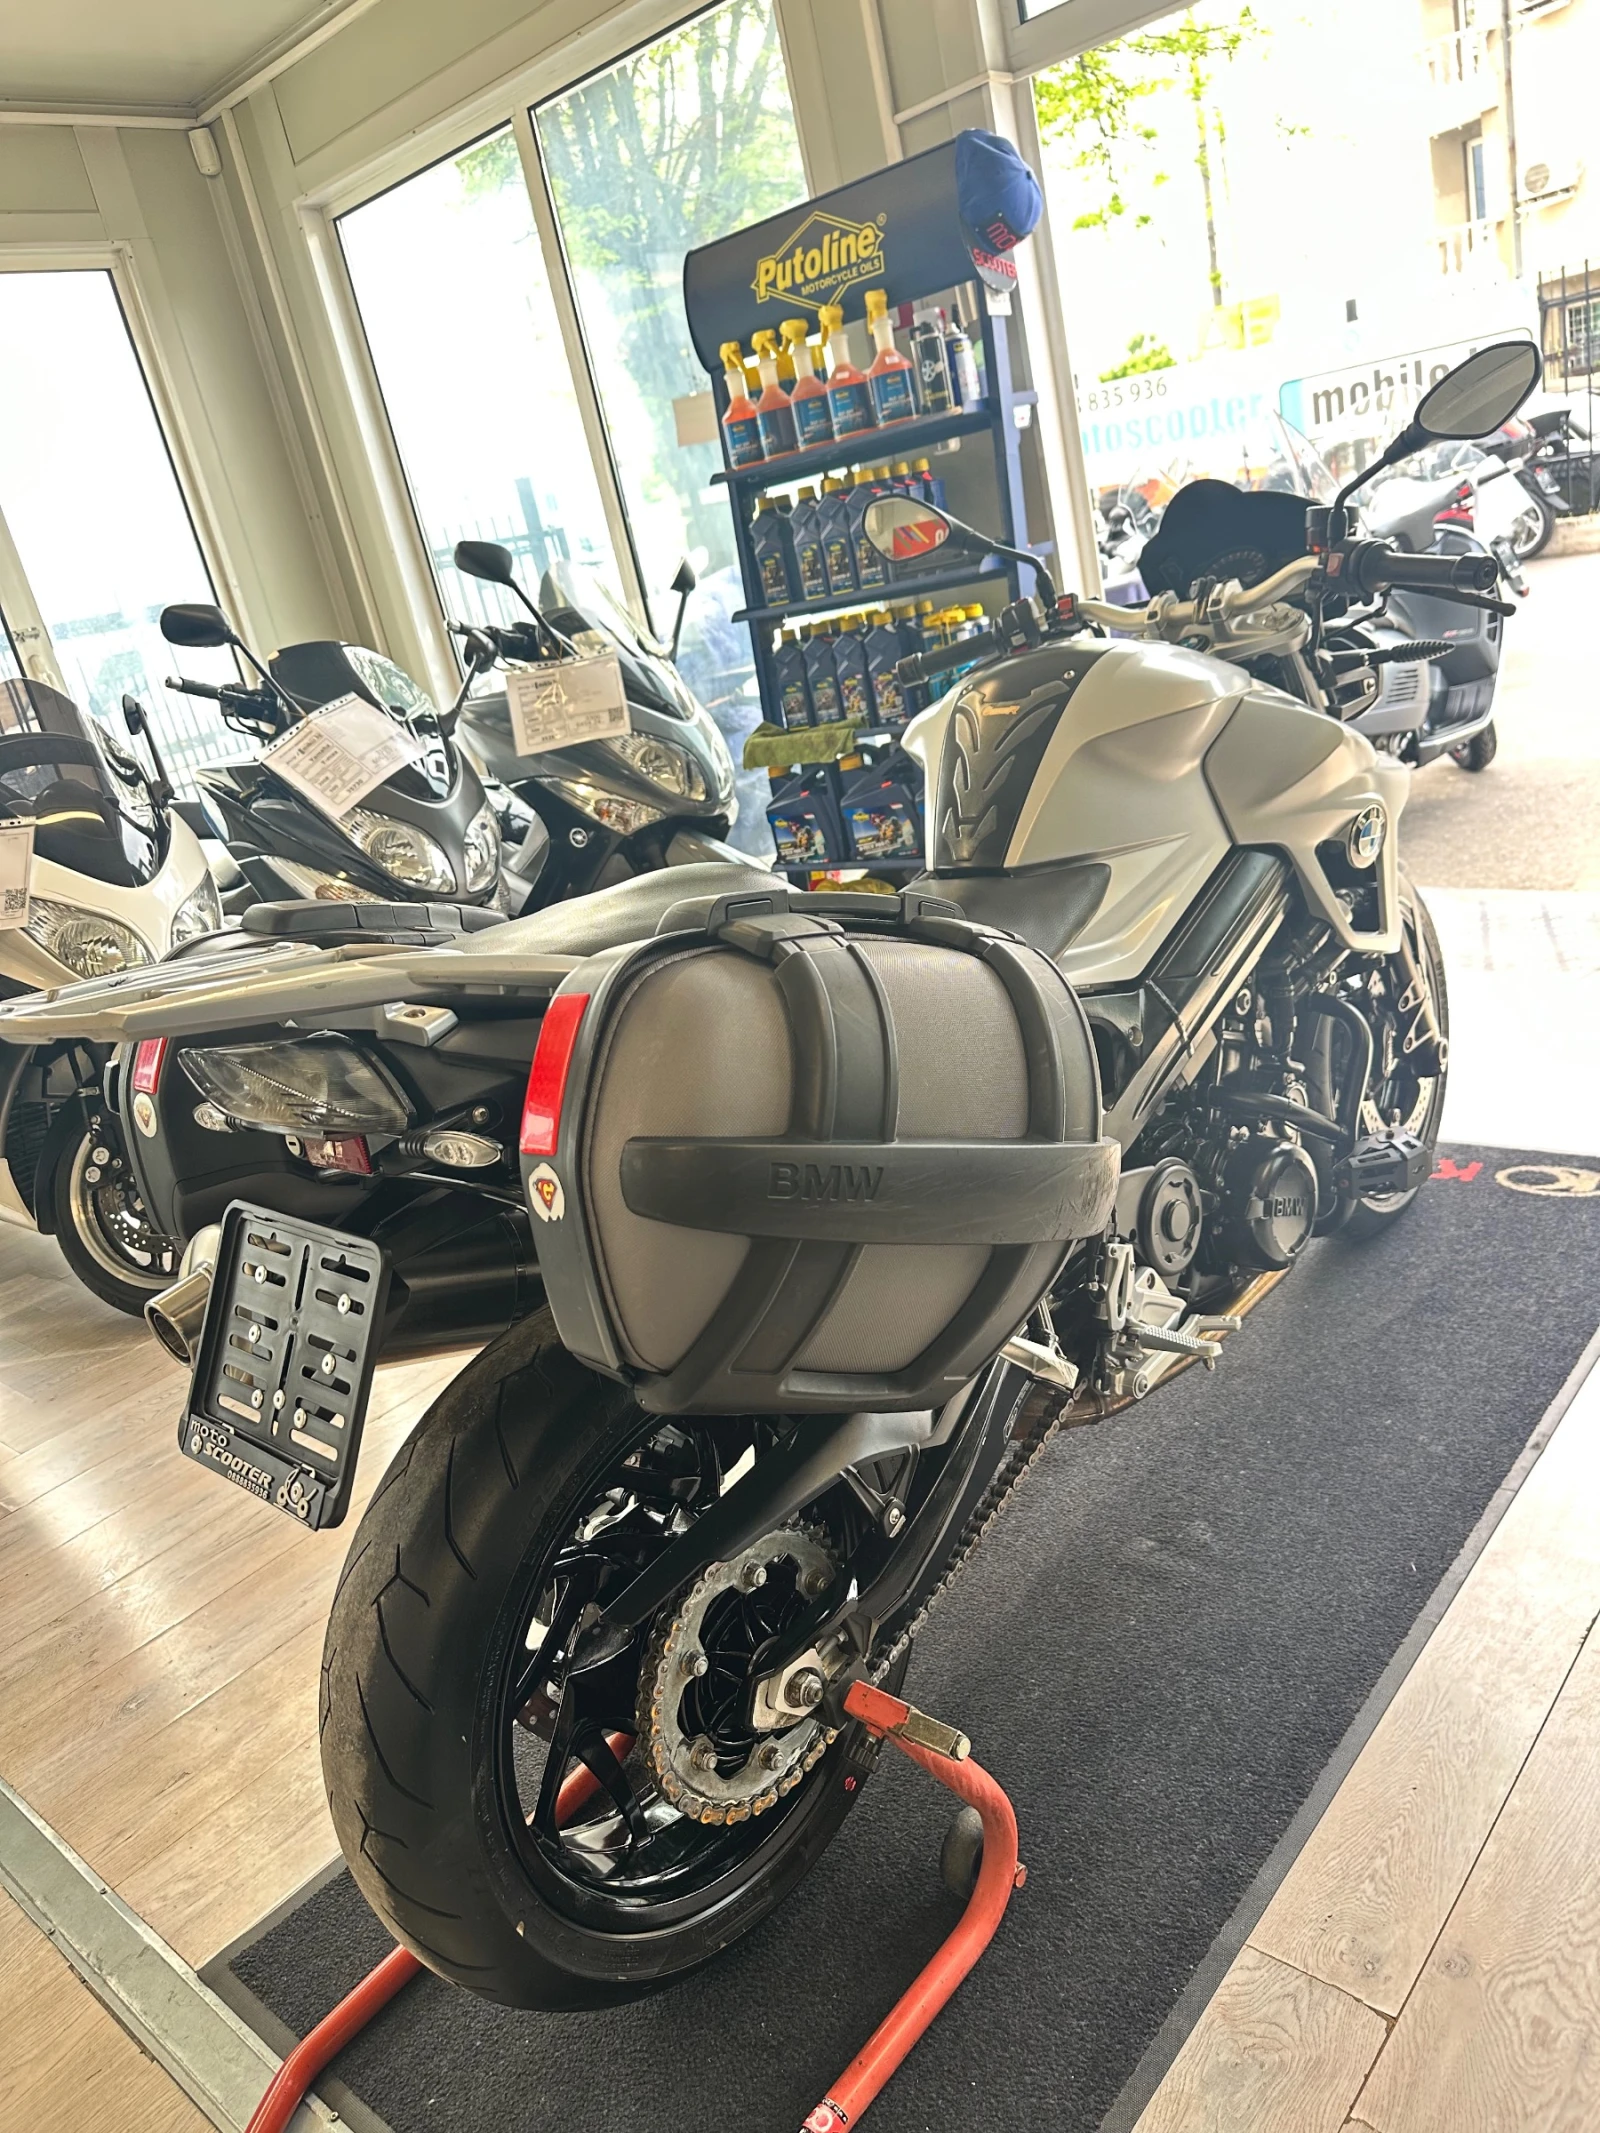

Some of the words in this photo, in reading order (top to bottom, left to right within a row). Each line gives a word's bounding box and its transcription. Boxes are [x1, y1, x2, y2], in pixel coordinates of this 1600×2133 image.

[759, 227, 876, 298] Putoline
[801, 266, 859, 296] MOTORCYCLE
[860, 258, 881, 274] OILS
[1088, 386, 1123, 412] 835
[1130, 376, 1167, 402] 936
[767, 1162, 885, 1202] BMW
[1274, 1196, 1306, 1217] BMW
[190, 1419, 228, 1447] moto
[203, 1442, 273, 1489] SCOOTER
[227, 1469, 269, 1500] 0888835936
